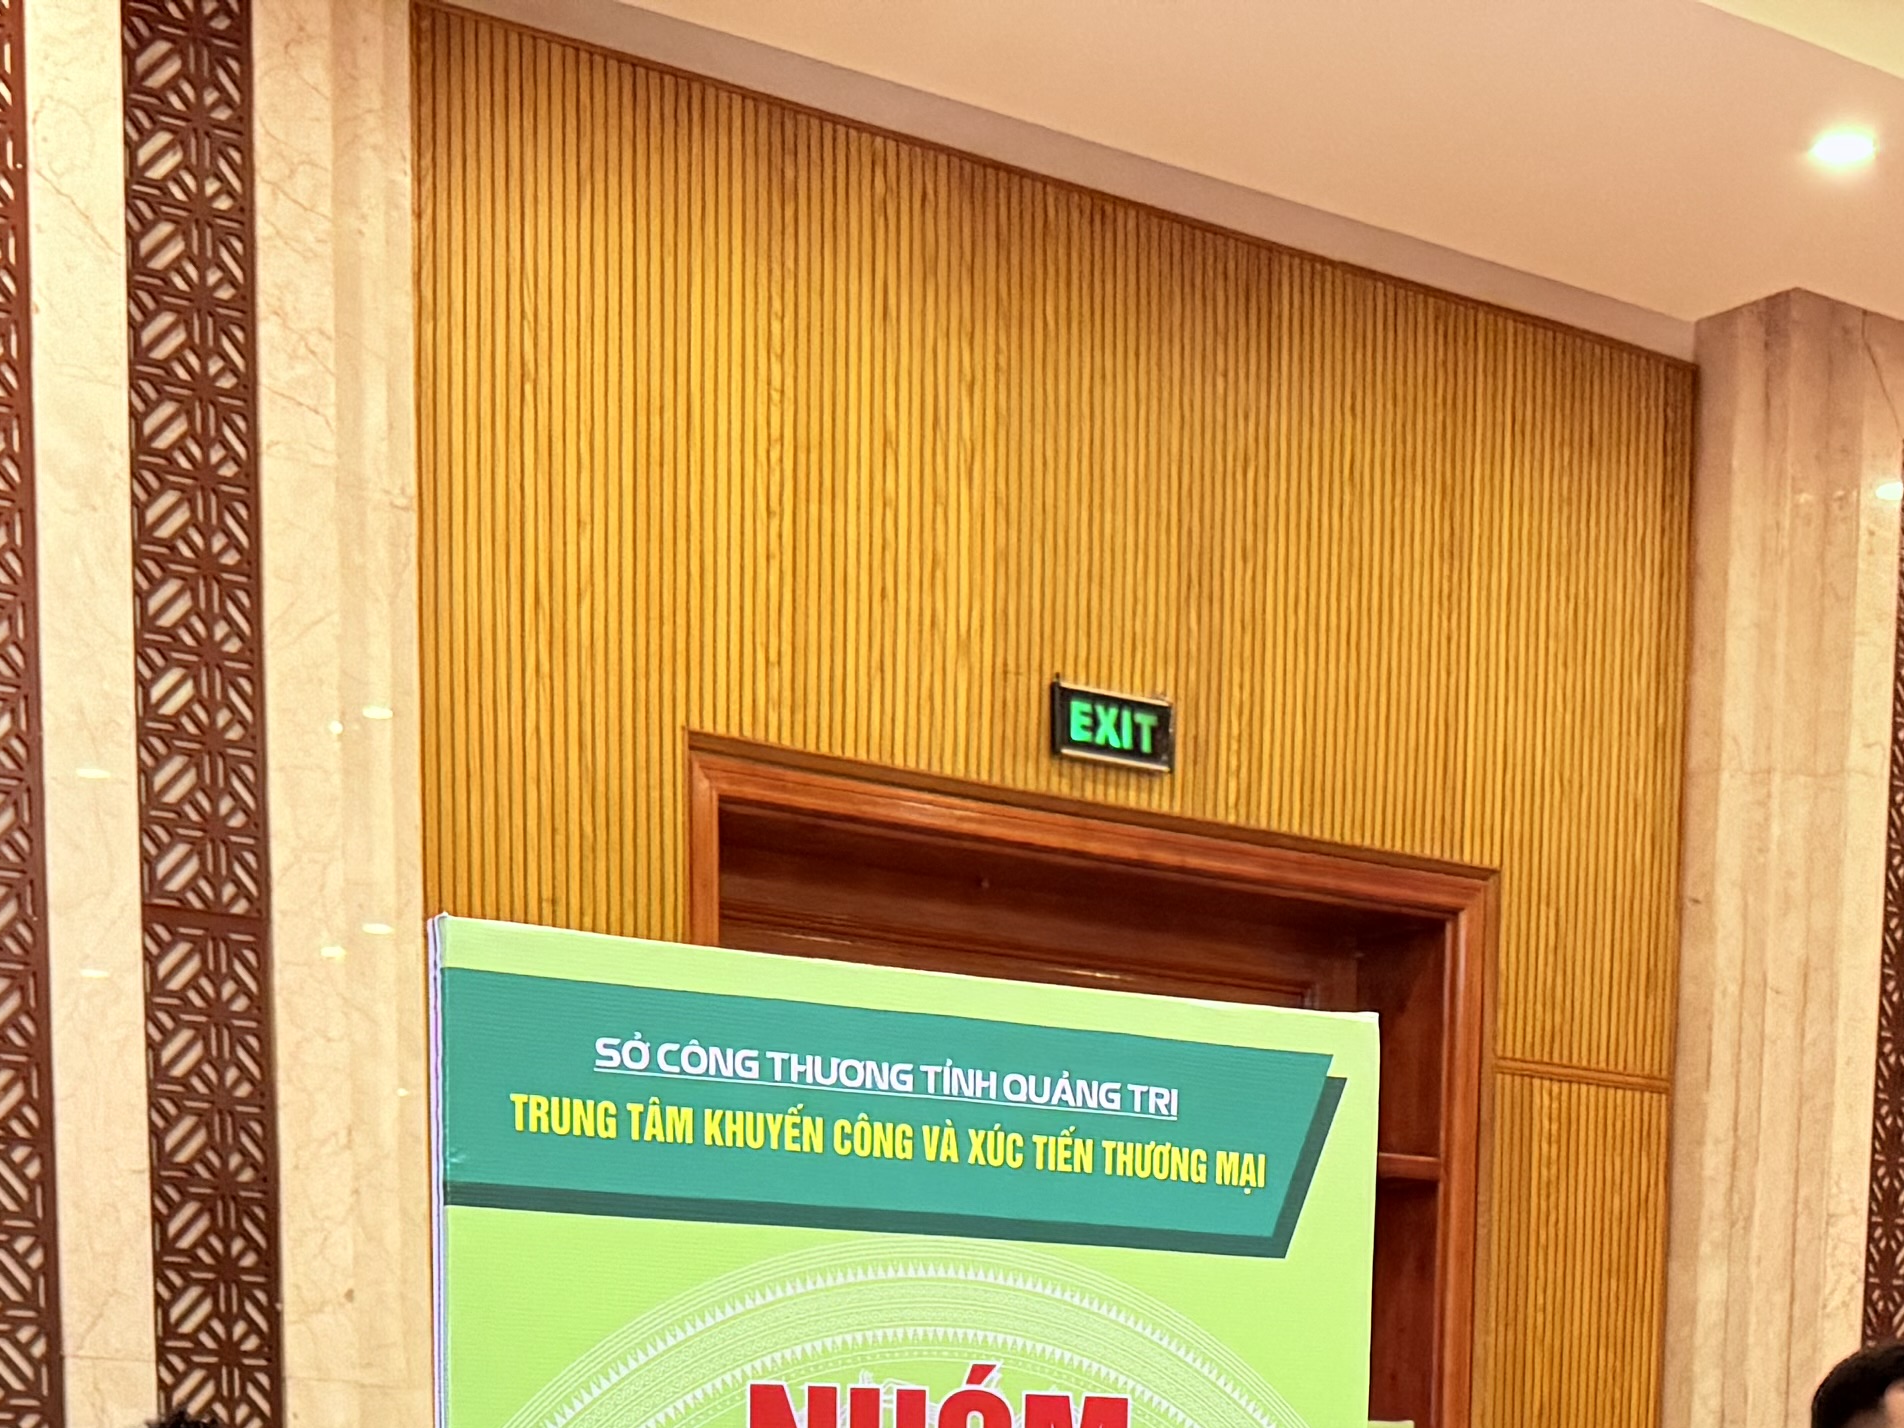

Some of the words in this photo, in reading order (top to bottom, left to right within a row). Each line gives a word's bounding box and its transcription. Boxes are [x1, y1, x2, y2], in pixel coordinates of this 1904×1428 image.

[1070, 701, 1158, 754] EXIT
[595, 1032, 650, 1070] SỞ
[657, 1039, 759, 1079] CÔNG
[1003, 1071, 1121, 1110] QUẢNG
[510, 1093, 617, 1138] TRUNG
[626, 1096, 693, 1144] TÂM
[704, 1103, 824, 1154] KHUYẾN
[833, 1113, 913, 1159] CÔNG
[922, 1119, 959, 1163] VÀ
[967, 1123, 1023, 1169] XÚC
[1032, 1126, 1093, 1174] TIẾN
[1101, 1140, 1207, 1184] THƯƠNG
[1215, 1149, 1266, 1195] MẠI
